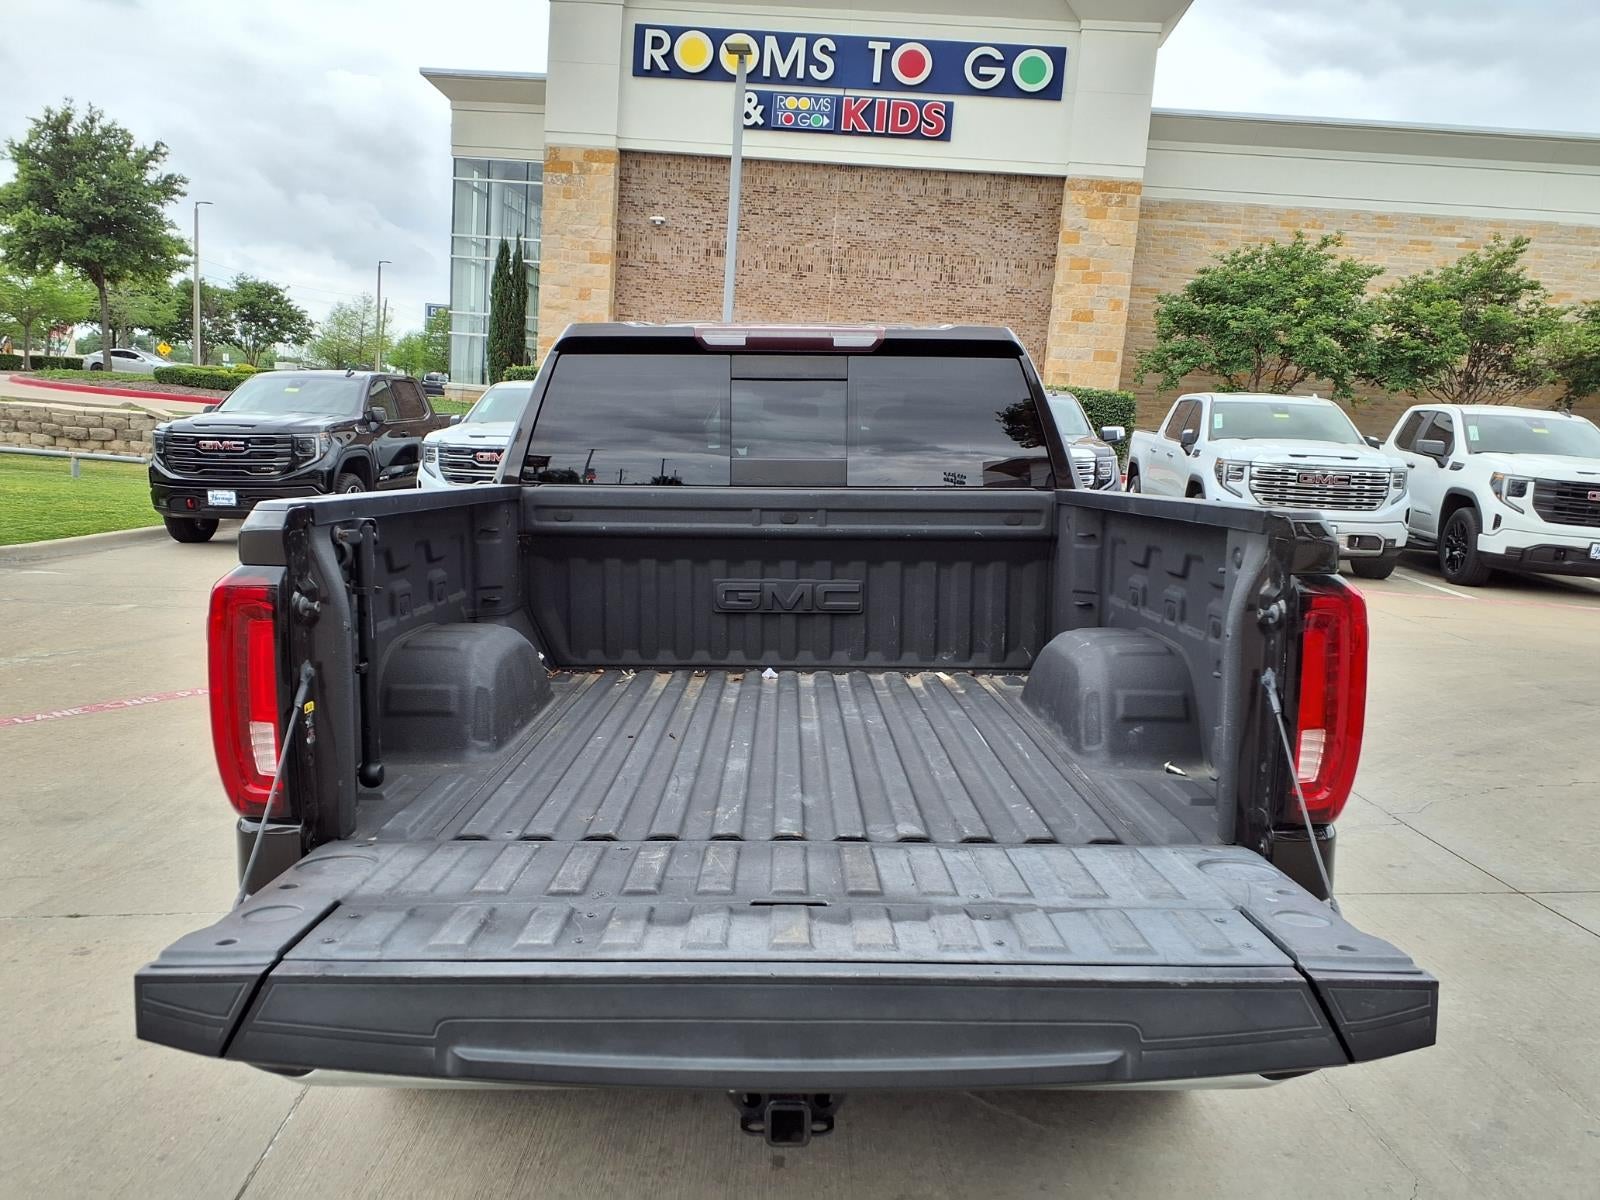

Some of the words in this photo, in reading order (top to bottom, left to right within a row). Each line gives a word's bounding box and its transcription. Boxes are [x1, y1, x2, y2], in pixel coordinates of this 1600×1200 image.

[643, 28, 836, 81] ROOMS
[867, 41, 933, 86] TO
[964, 46, 1054, 92] GO
[743, 91, 765, 126] &
[777, 95, 831, 112] ROOMS
[777, 111, 795, 126] TO
[797, 112, 824, 127] GO
[841, 96, 946, 137] KIDS
[198, 440, 245, 451] GMC
[476, 451, 504, 462] GM
[1299, 473, 1350, 485] GMC
[717, 582, 860, 610] GMC
